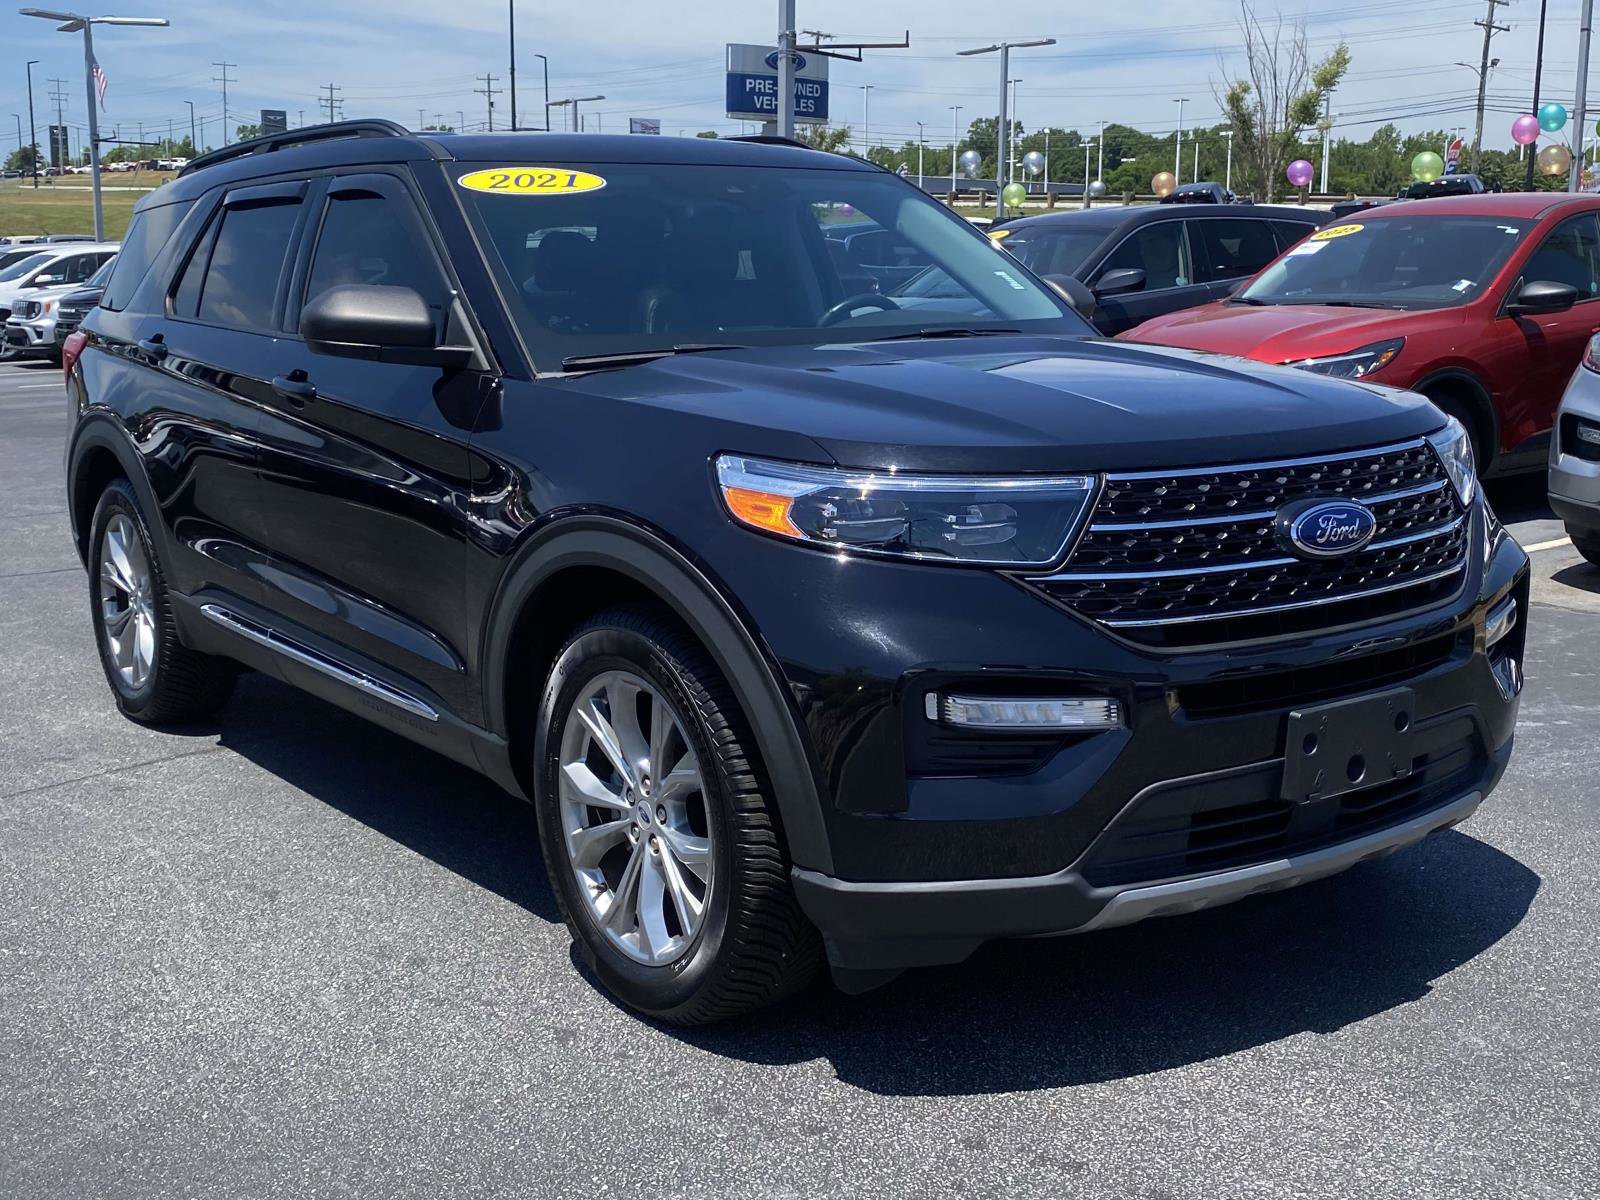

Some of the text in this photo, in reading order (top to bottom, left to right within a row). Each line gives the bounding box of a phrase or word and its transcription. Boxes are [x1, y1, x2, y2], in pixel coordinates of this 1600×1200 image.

[745, 78, 821, 97] PRE-NED
[753, 95, 815, 112] VEHLES
[489, 173, 578, 189] 2021
[1316, 513, 1360, 544] Ford
